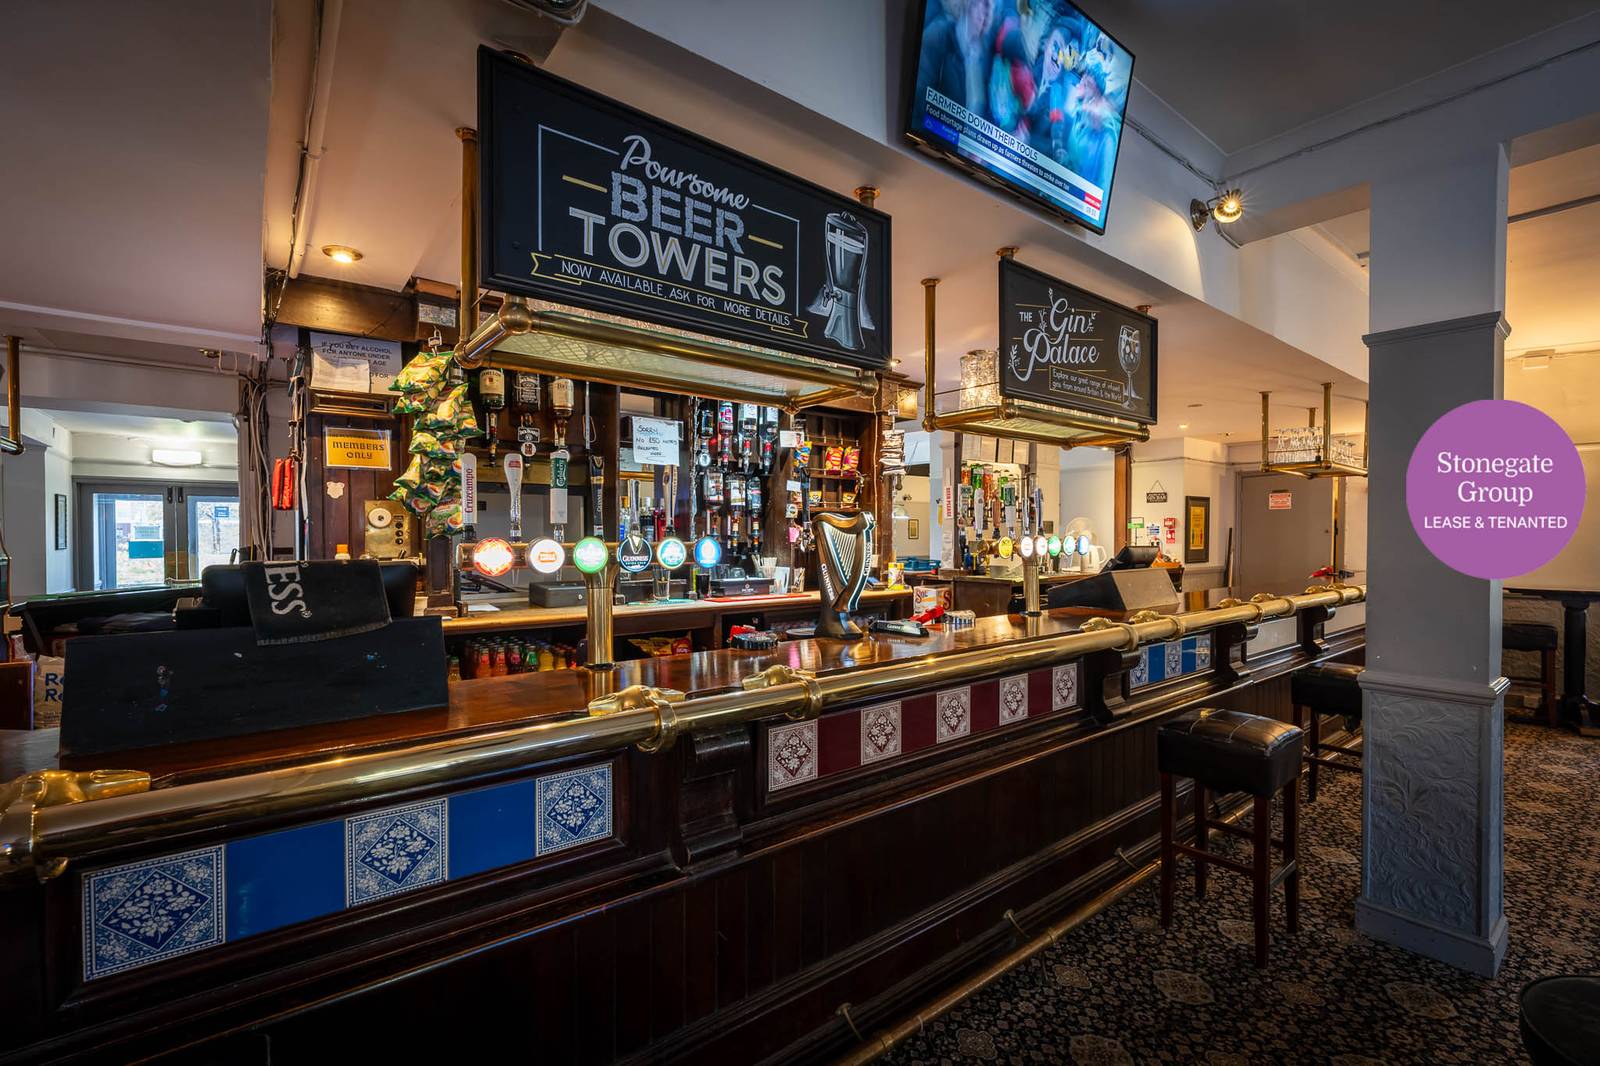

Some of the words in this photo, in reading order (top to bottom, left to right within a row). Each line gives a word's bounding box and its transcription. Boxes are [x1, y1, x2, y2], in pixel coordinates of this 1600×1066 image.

[926, 104, 940, 118] Food
[927, 89, 967, 120] FARMERS
[968, 113, 993, 135] DOWN
[994, 128, 1015, 148] THEIR
[1016, 141, 1038, 161] TOOLS
[620, 134, 750, 210] Poursome
[610, 170, 745, 254] BEER
[568, 206, 786, 306] TOWERS
[561, 260, 592, 280] NOW
[669, 287, 691, 304] ASK
[697, 293, 716, 310] FOR
[724, 301, 751, 318] MORE
[755, 306, 790, 326] DETAILS
[1019, 311, 1033, 323] THE
[1049, 298, 1089, 344] Gin
[361, 345, 392, 354] ALCOHOL
[1014, 328, 1100, 382] Palace
[332, 441, 385, 451] MEMBERS
[346, 451, 373, 460] ONLY
[465, 468, 474, 513] Cruzcampo
